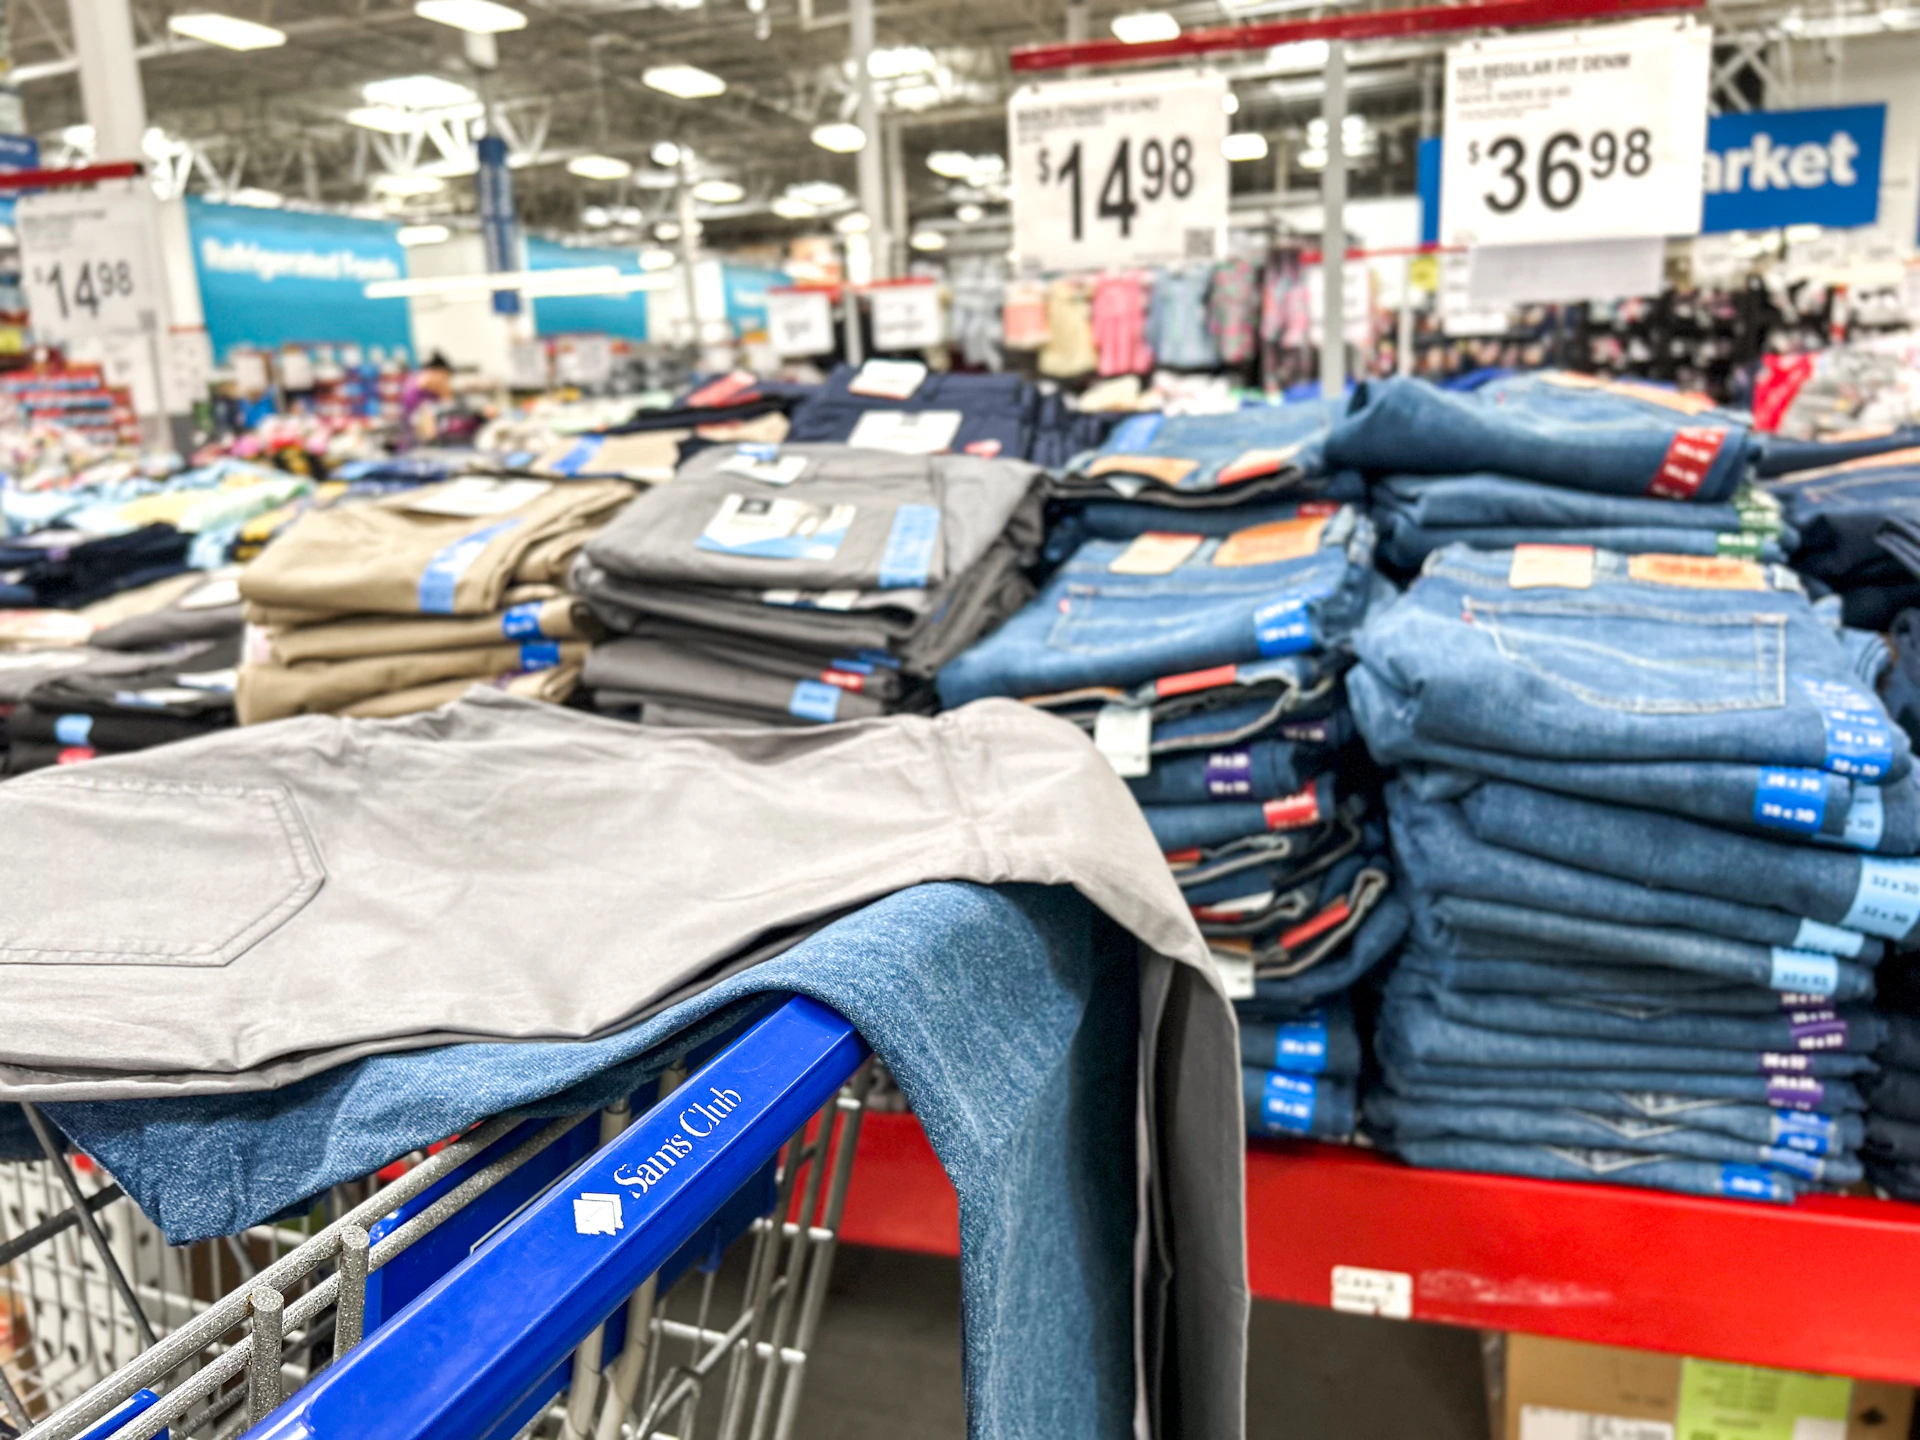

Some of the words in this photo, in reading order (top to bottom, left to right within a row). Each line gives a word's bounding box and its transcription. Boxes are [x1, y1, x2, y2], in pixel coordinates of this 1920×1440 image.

[1483, 59, 1552, 81] REGULAR
[613, 1134, 693, 1199] Sam's
[679, 1087, 742, 1137] Club
